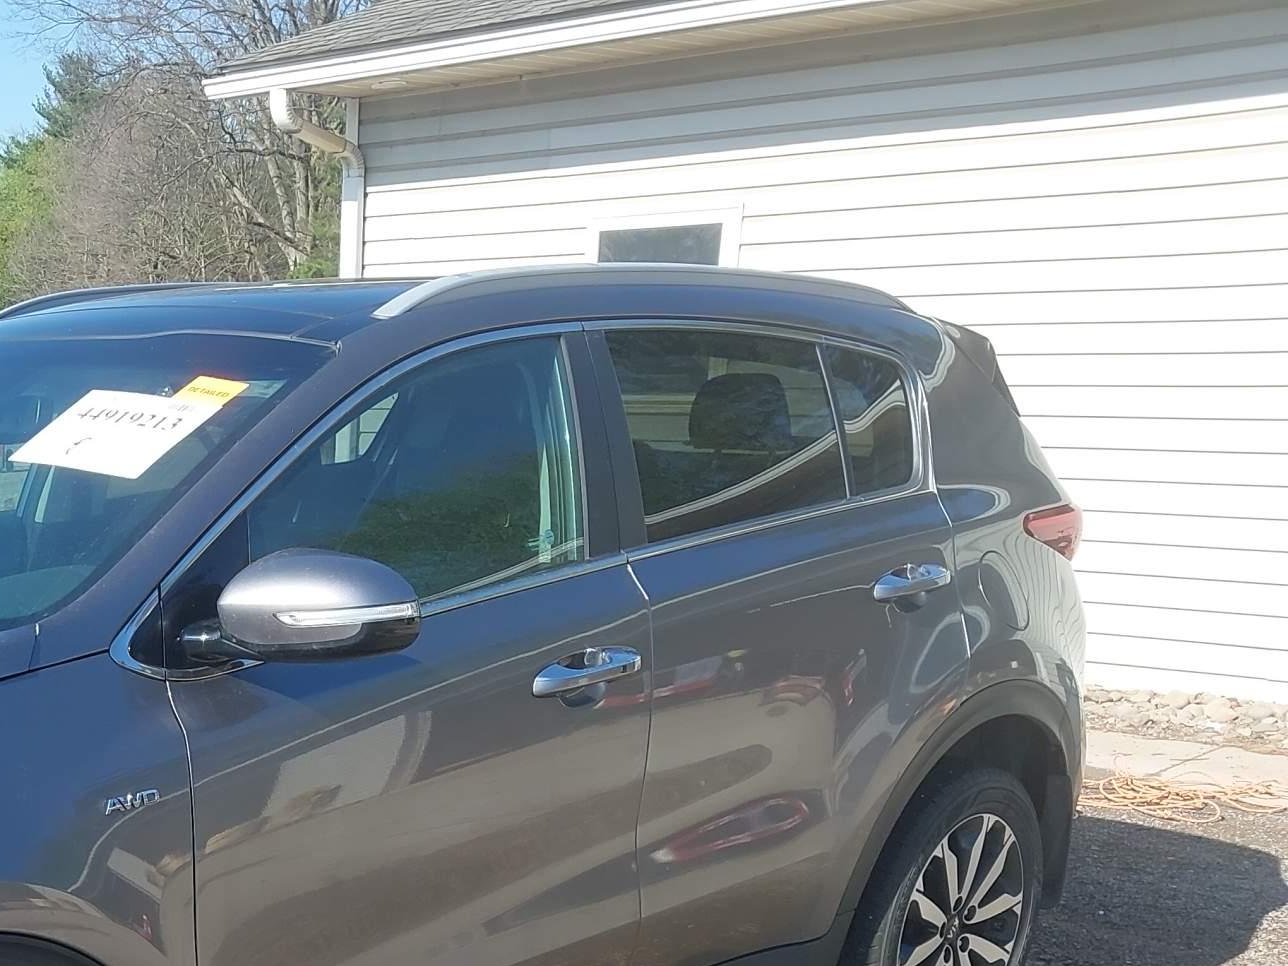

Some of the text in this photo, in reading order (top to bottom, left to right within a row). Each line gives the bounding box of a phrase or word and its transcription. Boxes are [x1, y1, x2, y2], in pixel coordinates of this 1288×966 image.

[187, 386, 230, 398] DETAILED
[76, 406, 184, 431] 44919213
[104, 788, 160, 816] AWD
